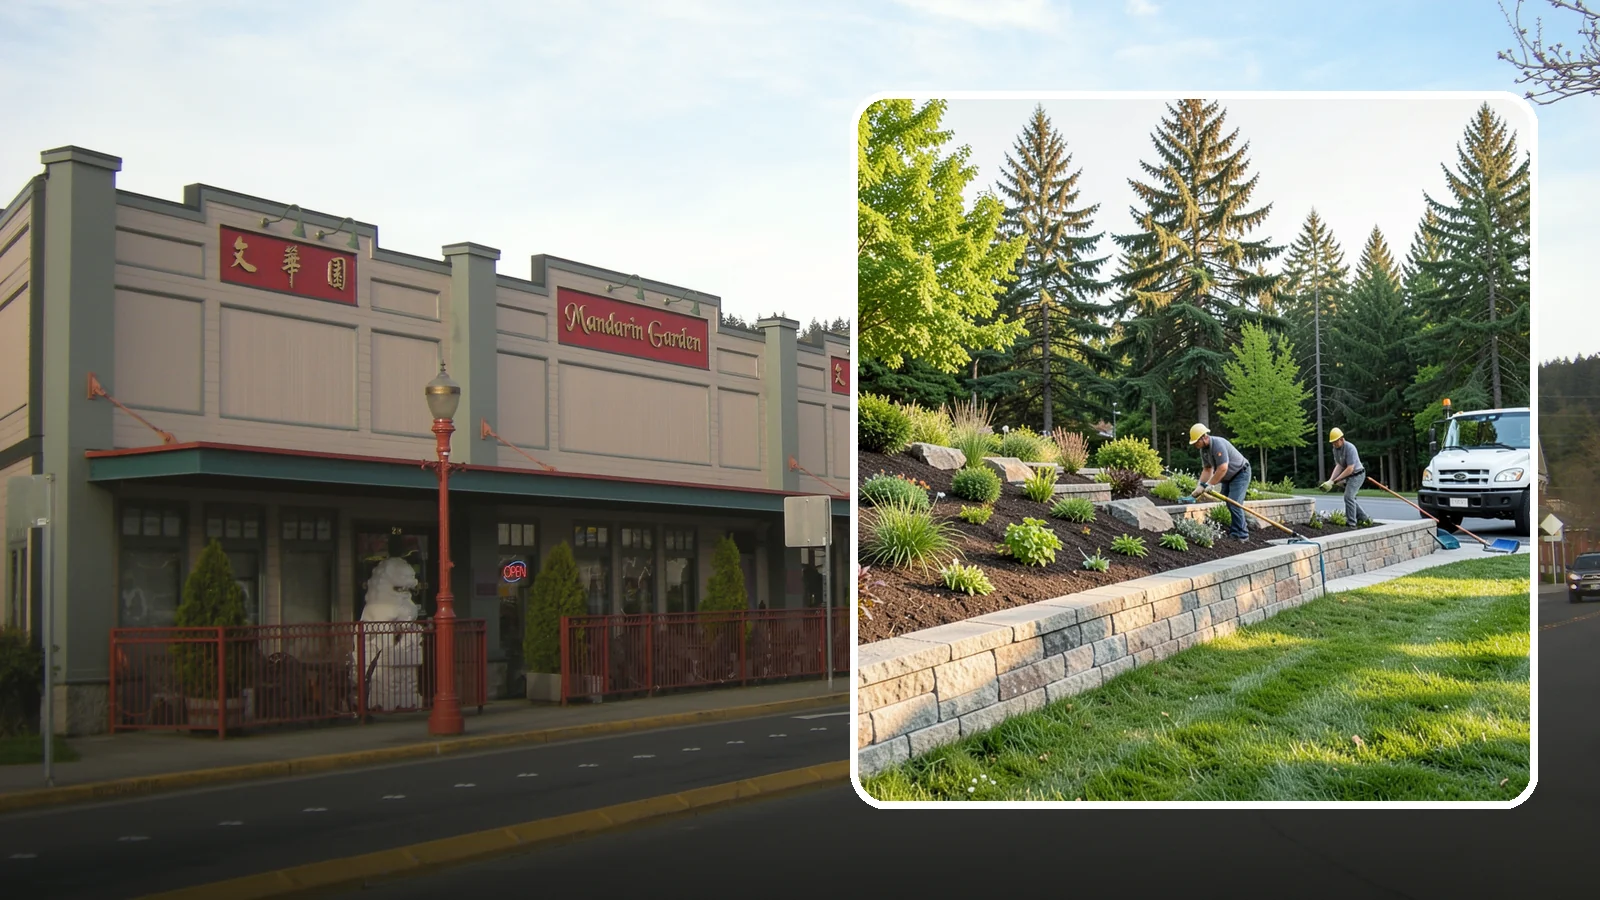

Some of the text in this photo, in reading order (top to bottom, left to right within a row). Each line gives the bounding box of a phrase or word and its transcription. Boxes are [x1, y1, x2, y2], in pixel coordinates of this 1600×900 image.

[564, 302, 702, 352] Mandarin Garden
[503, 565, 527, 578] OPEN
